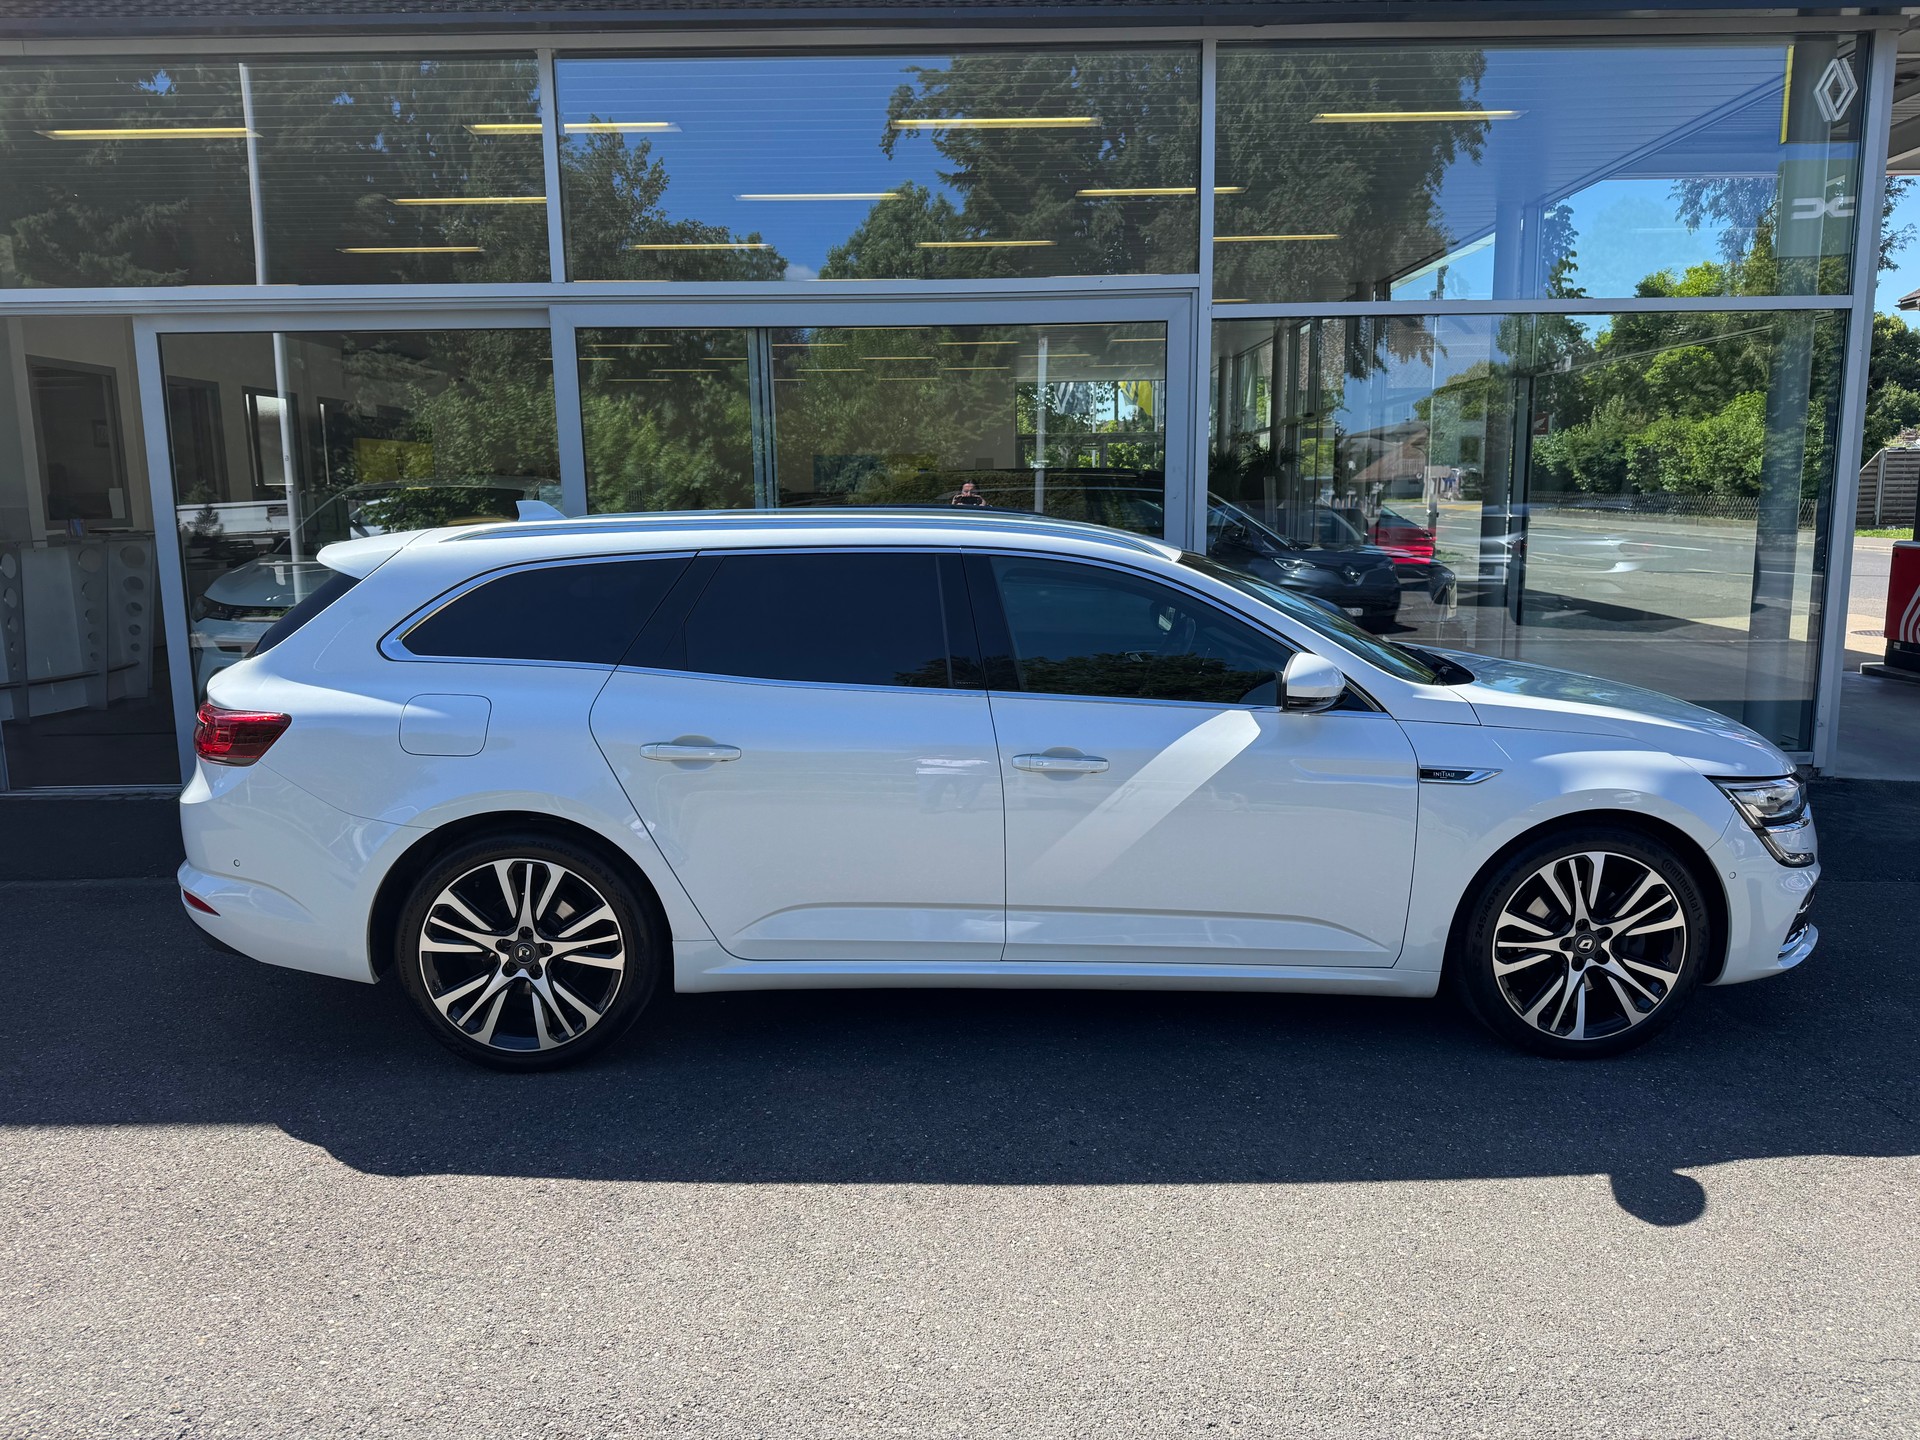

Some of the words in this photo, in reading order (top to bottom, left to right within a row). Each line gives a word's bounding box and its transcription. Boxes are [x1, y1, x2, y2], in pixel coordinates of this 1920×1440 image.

[1662, 859, 1701, 913] Continental
[1475, 896, 1495, 938] 245/40
[1492, 887, 1502, 897] R
